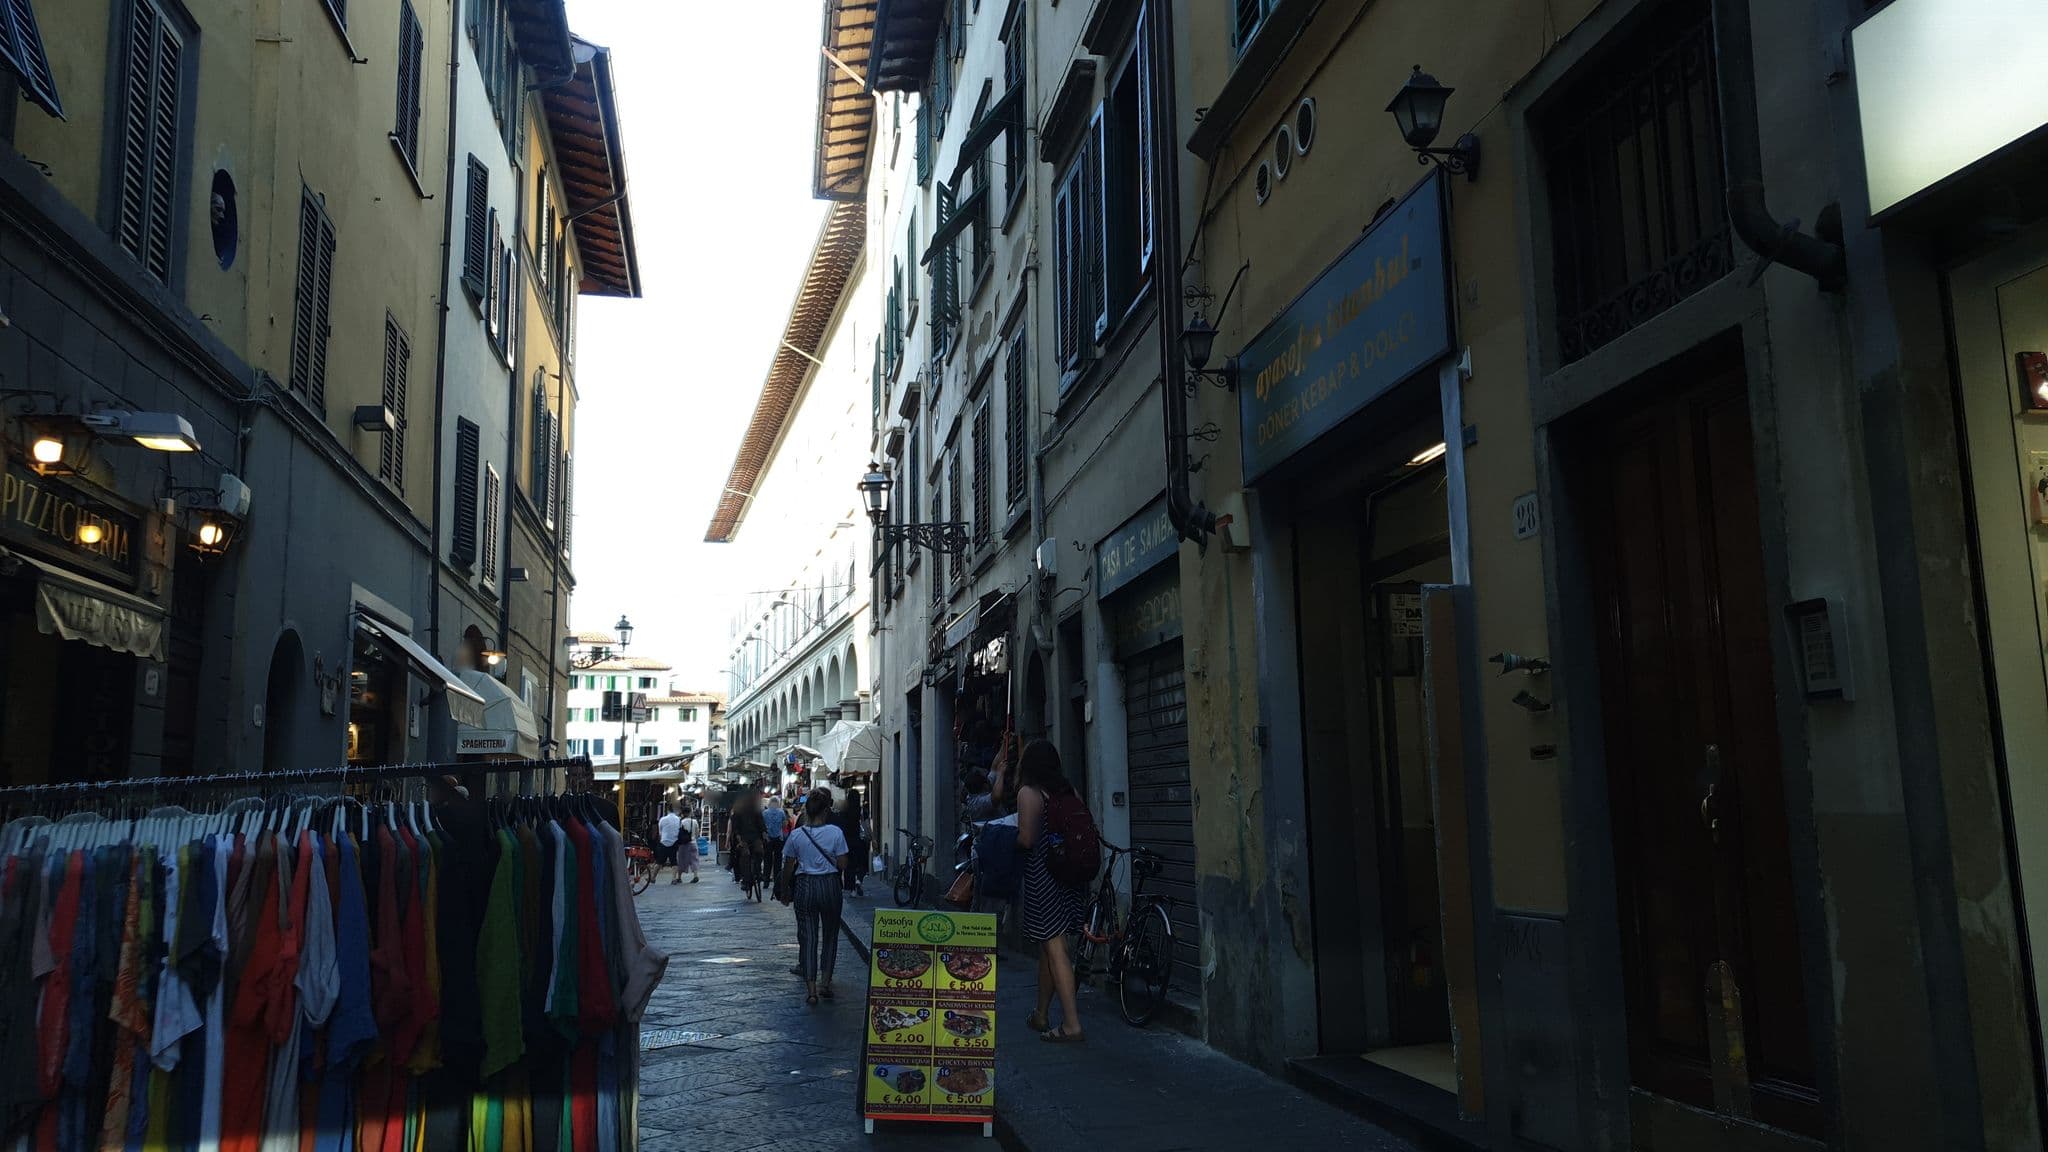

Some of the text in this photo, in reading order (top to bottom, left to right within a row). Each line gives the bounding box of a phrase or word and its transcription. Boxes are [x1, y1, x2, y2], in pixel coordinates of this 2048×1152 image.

[1301, 361, 1345, 413] KEBAP
[2, 472, 129, 563] PIZZICHERIA
[1102, 513, 1174, 582] CASA DE SAMBA
[462, 740, 506, 749] SPAGHETTERIA
[877, 916, 913, 929] Ayasofya
[879, 930, 911, 939] Istanbul
[885, 979, 891, 988] €
[949, 981, 956, 990] €
[880, 1033, 887, 1043] €
[953, 1039, 960, 1047] €
[883, 1094, 890, 1104] €
[946, 1094, 953, 1104] €
